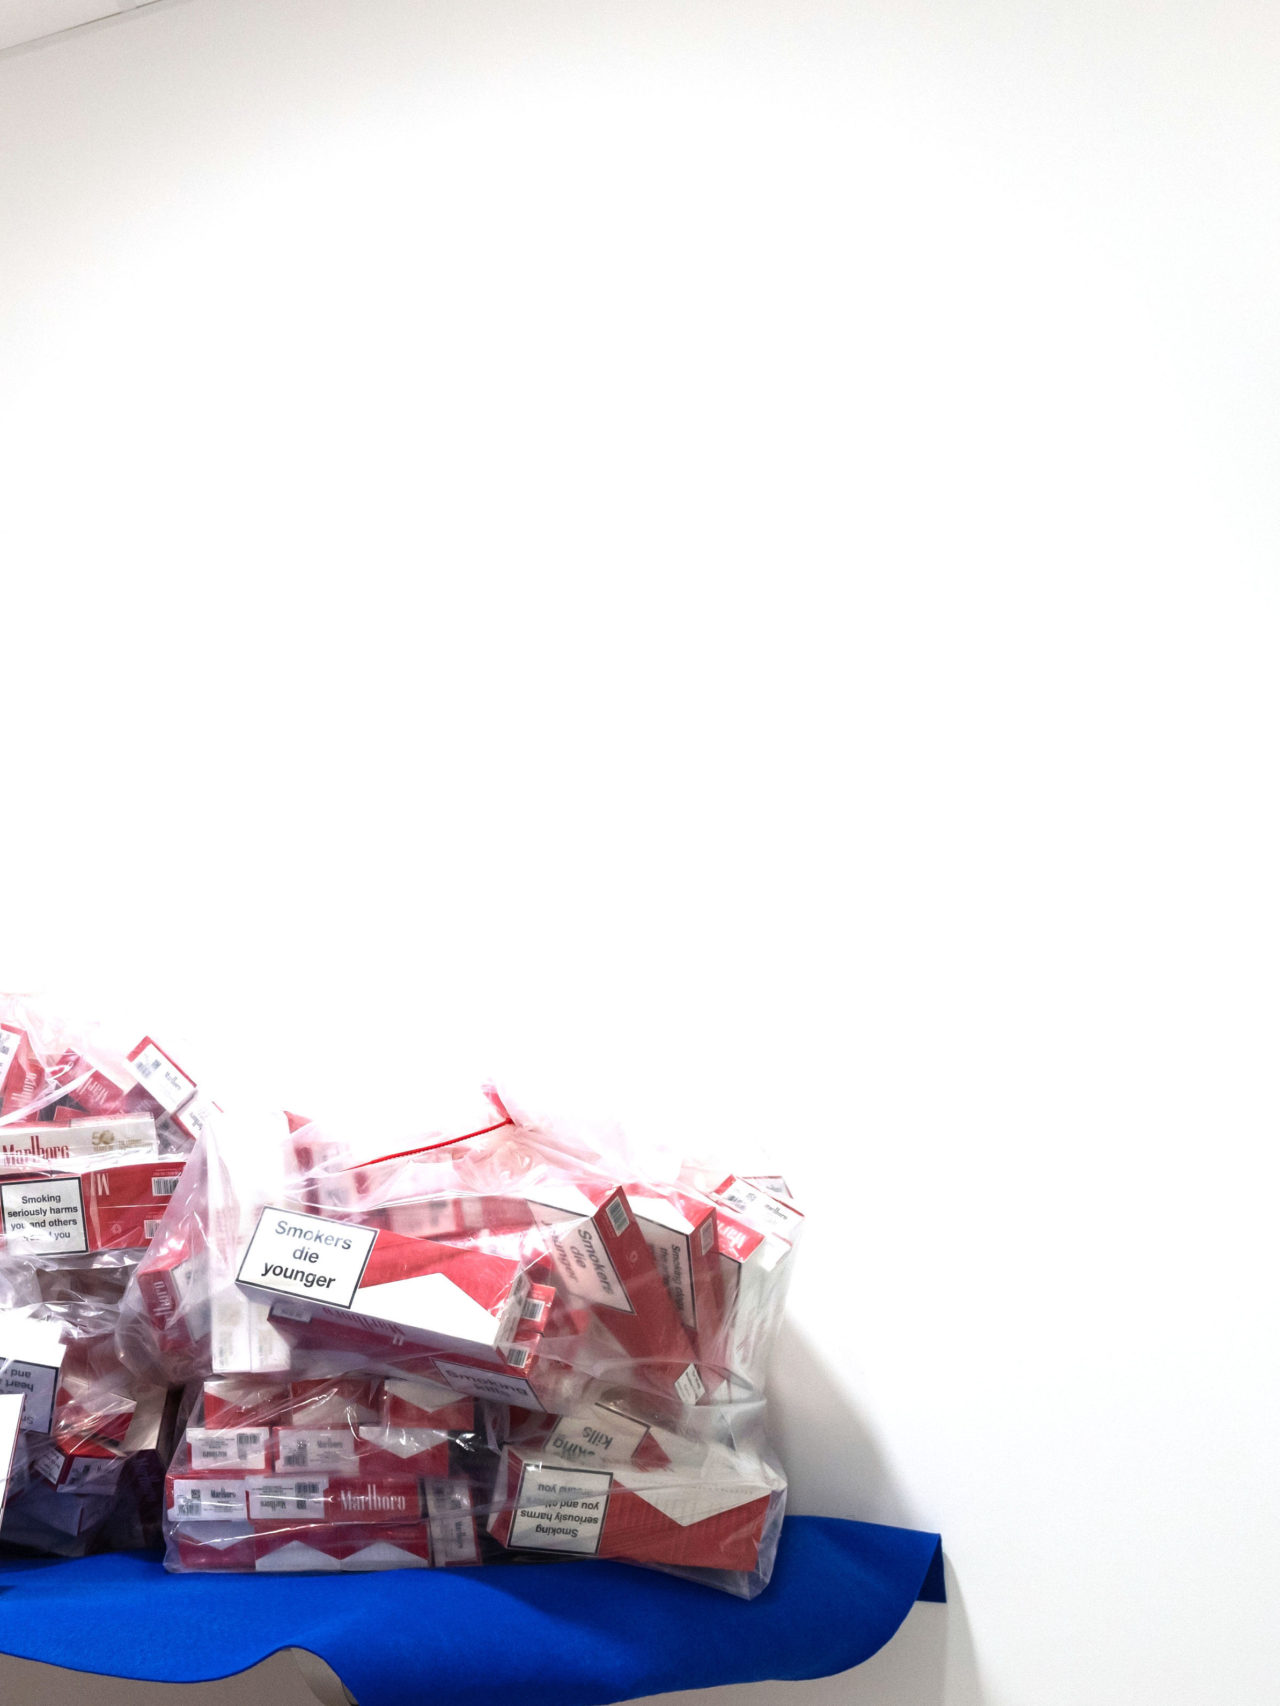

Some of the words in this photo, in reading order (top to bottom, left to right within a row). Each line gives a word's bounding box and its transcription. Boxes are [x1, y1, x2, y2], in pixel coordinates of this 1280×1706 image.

[21, 1193, 61, 1204] Smoking
[7, 1206, 48, 1218] seriously
[49, 1205, 79, 1215] harms
[48, 1218, 78, 1227] others
[54, 1231, 71, 1240] you
[275, 1220, 353, 1250] Smokers
[292, 1246, 319, 1263] die
[570, 1246, 587, 1269] die
[261, 1262, 336, 1288] younger
[10, 1369, 32, 1379] and
[5, 1381, 34, 1393] heart
[582, 1426, 614, 1450] kills
[538, 1484, 557, 1494] you
[340, 1484, 406, 1511] Marlboro
[581, 1502, 600, 1510] you
[520, 1510, 553, 1522] harms
[555, 1513, 599, 1525] seriously
[535, 1524, 579, 1538] Smoking
